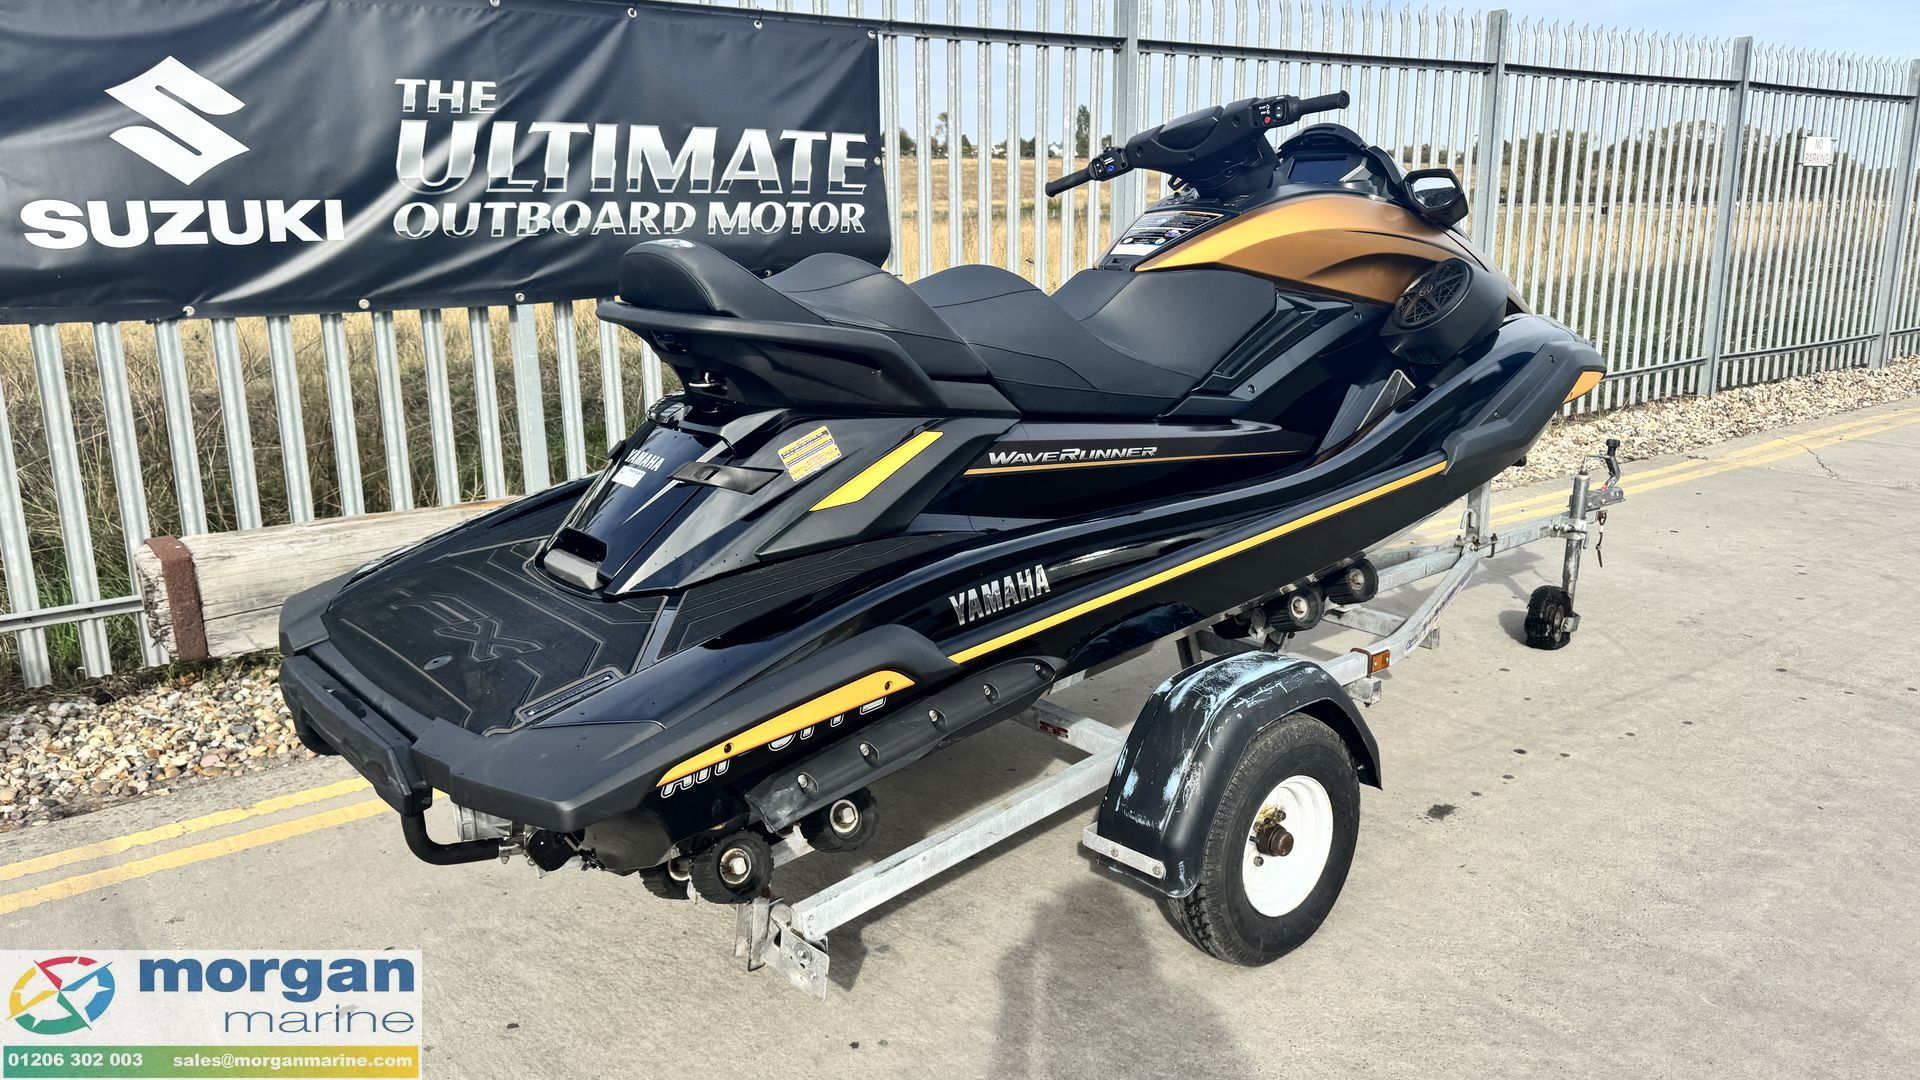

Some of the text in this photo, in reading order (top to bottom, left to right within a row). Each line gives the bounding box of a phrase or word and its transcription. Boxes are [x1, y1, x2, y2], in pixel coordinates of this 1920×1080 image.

[395, 78, 496, 114] THE
[396, 119, 868, 195] ULTIMATE
[1814, 138, 1824, 150] NO
[21, 199, 345, 250] SUZUKI
[393, 202, 866, 238] OUTBOARD MOTOR
[624, 448, 665, 471] YAMAHA
[948, 564, 1051, 626] YAMAHA
